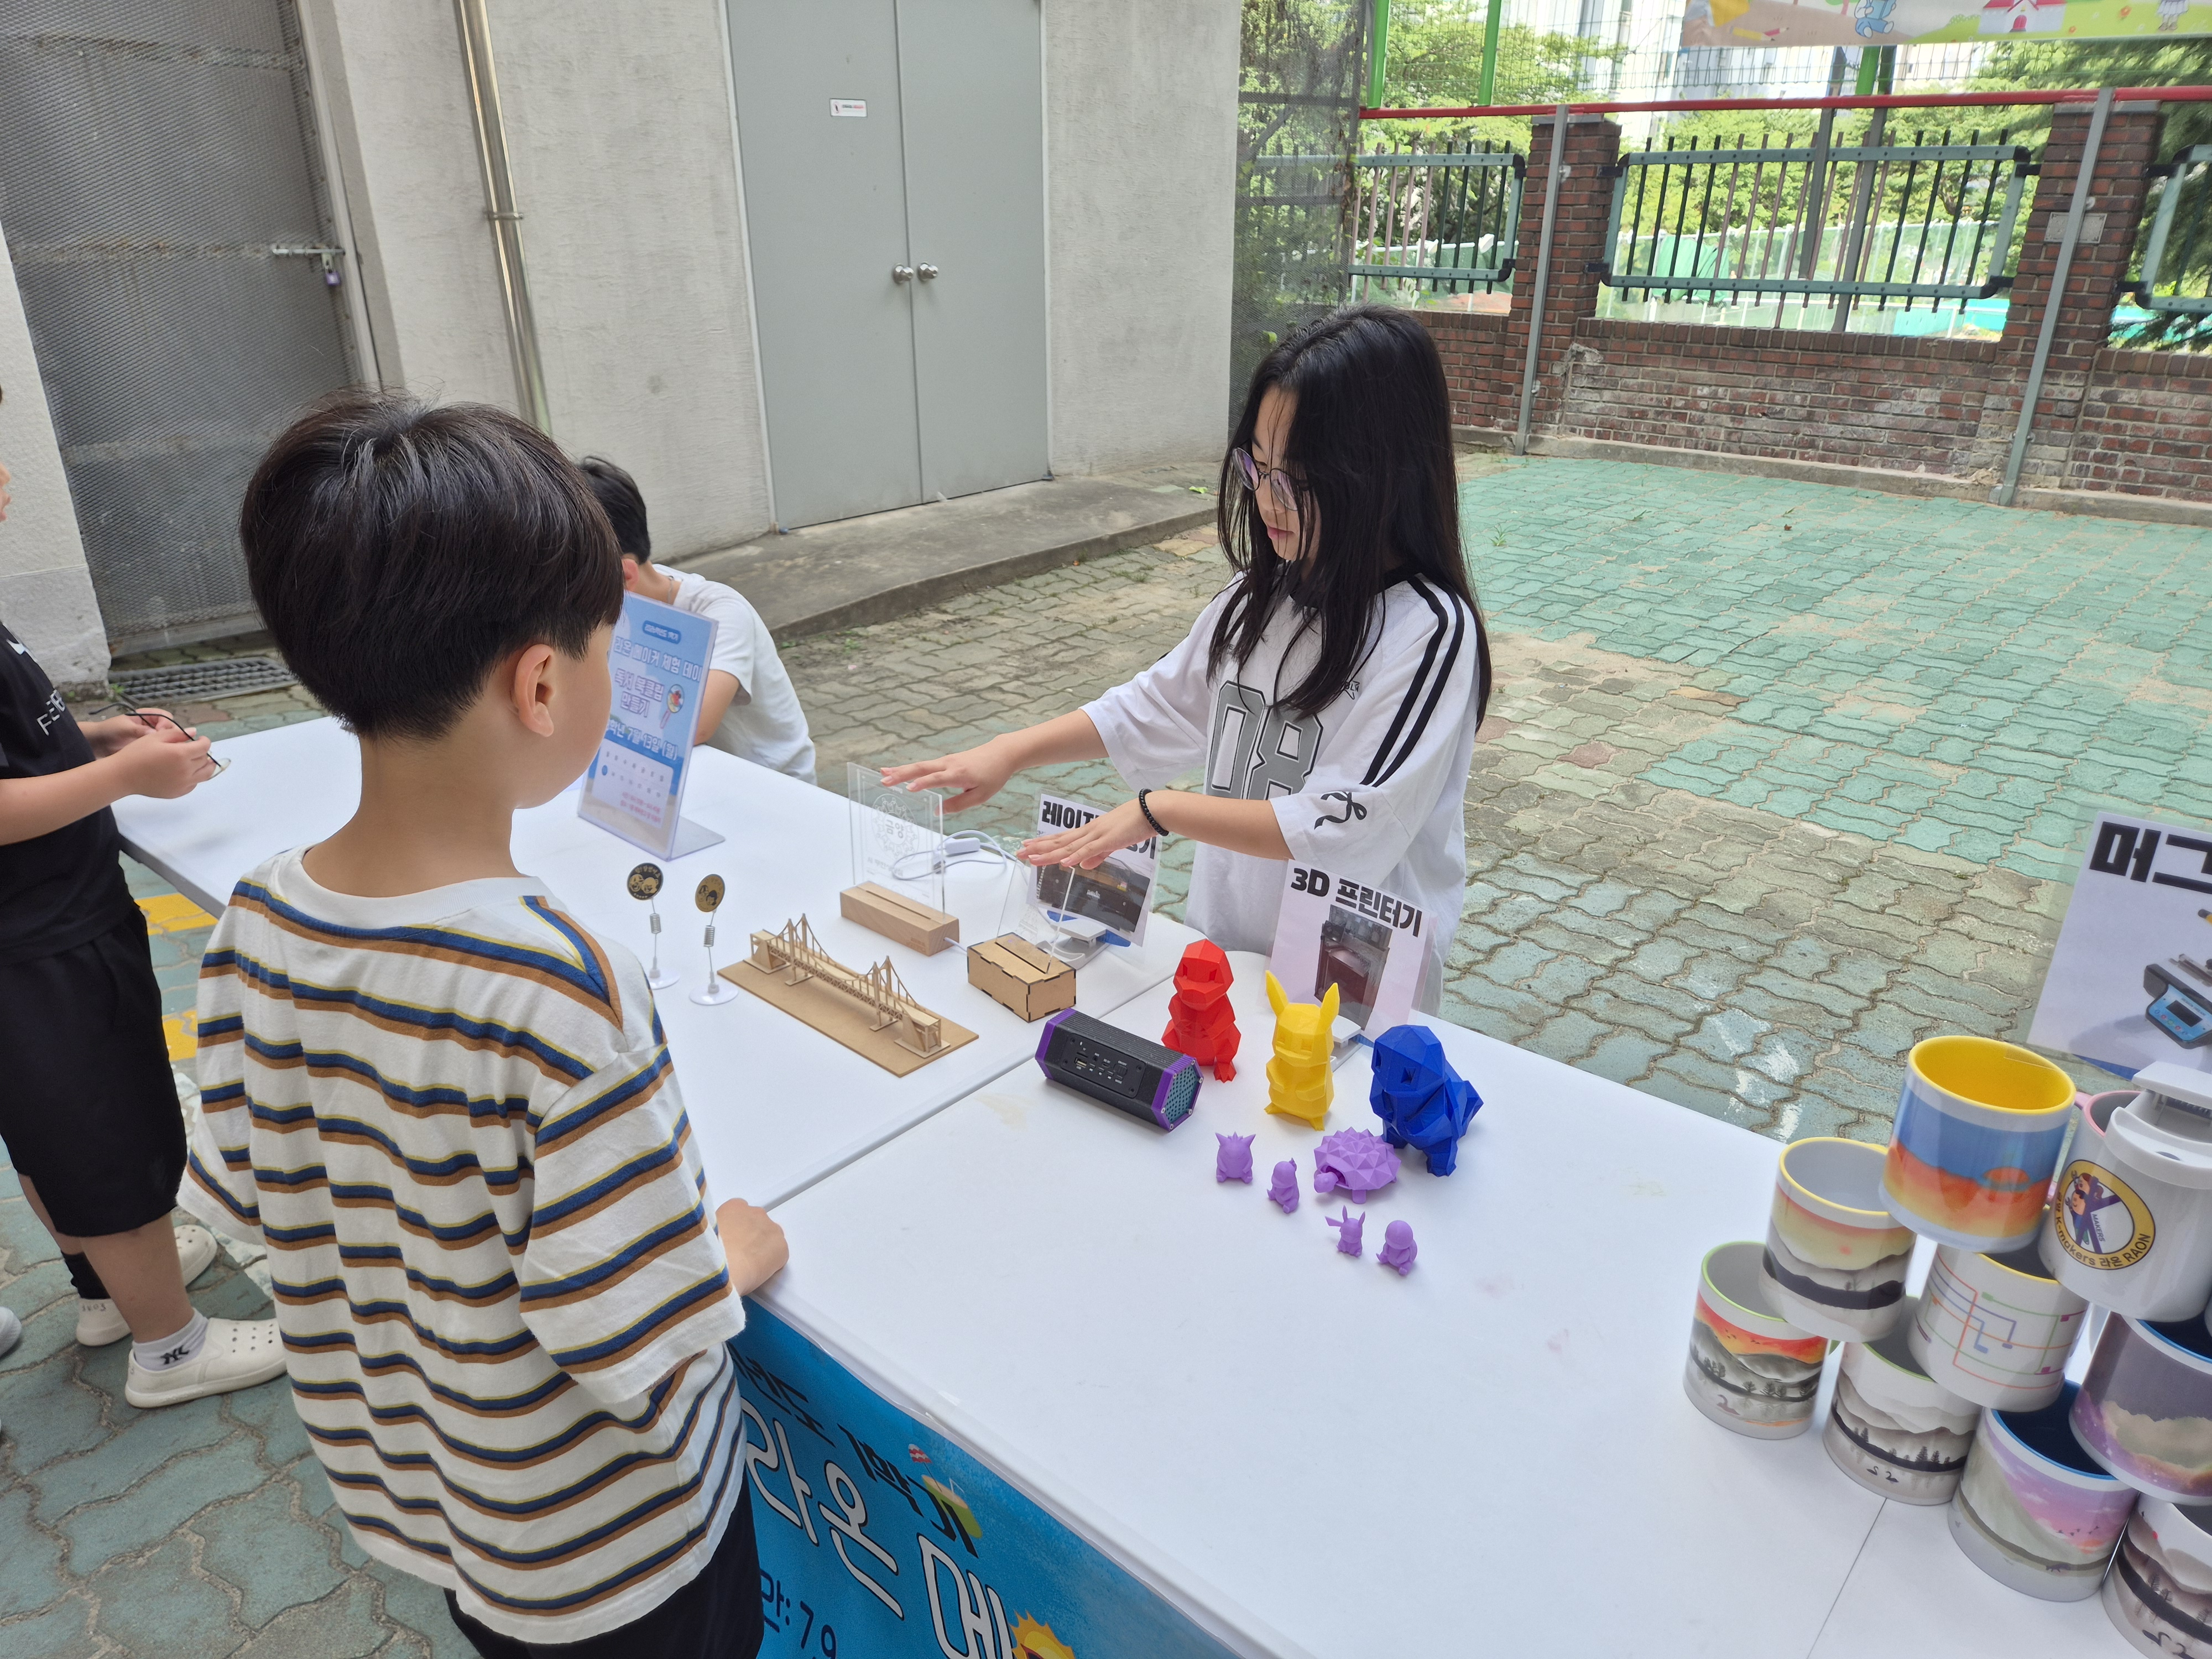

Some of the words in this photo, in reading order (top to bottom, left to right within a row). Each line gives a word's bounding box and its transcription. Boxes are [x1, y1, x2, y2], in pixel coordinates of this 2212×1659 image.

[615, 667, 635, 690] 독서
[635, 675, 665, 702] 북클립
[662, 653, 682, 675] 체험
[682, 660, 702, 682] 데이
[620, 691, 650, 718] 만들기
[627, 726, 642, 745] 7월
[643, 733, 661, 753] 13일
[662, 740, 678, 761] (월)
[1204, 679, 1324, 801] 08
[1291, 868, 1330, 897] 3D
[1335, 878, 1423, 938] 프린터기
[2056, 1217, 2096, 1266] K-makers
[2099, 1256, 2124, 1267] 라온
[2122, 1233, 2151, 1262] RAON
[2093, 1213, 2105, 1242] MAKERS
[741, 1395, 905, 1621] 라온
[837, 1423, 979, 1558] 1학기
